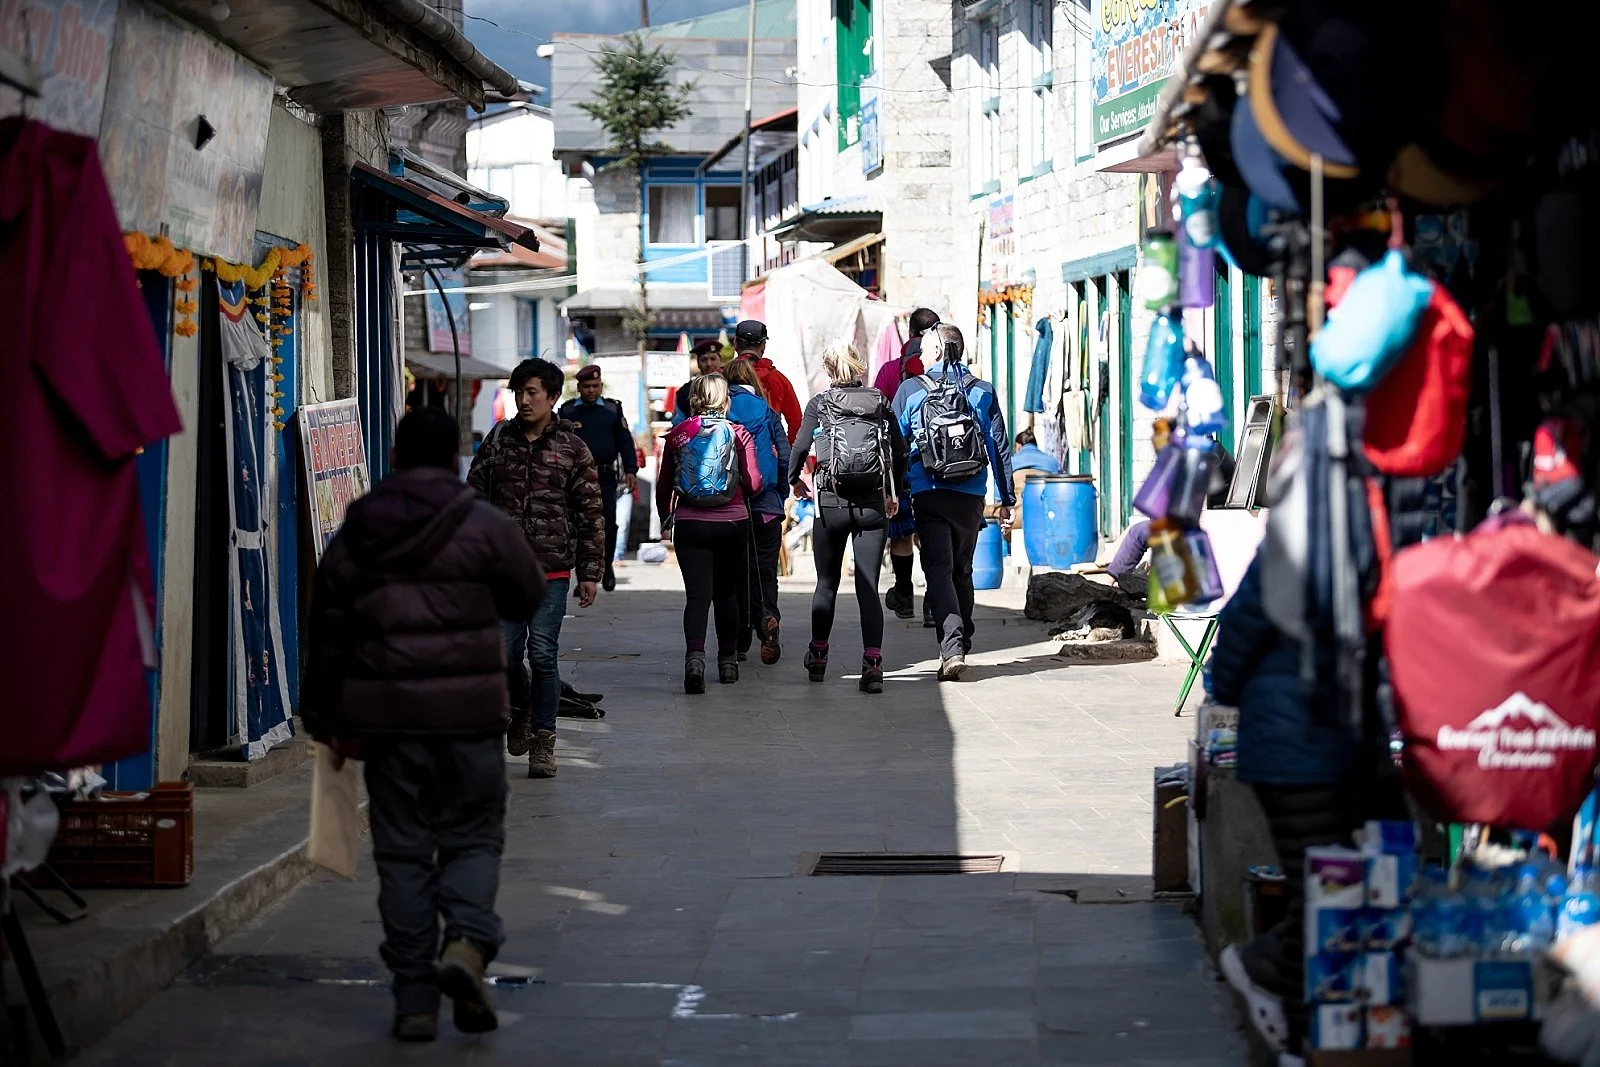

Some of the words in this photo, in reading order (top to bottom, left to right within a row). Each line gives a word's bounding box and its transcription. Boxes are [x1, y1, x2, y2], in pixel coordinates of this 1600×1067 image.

[53, 2, 107, 100] Shop
[1107, 26, 1167, 89] EVEREST
[1099, 114, 1110, 135] Our
[1110, 107, 1137, 131] Services:
[311, 421, 364, 474] BARBER
